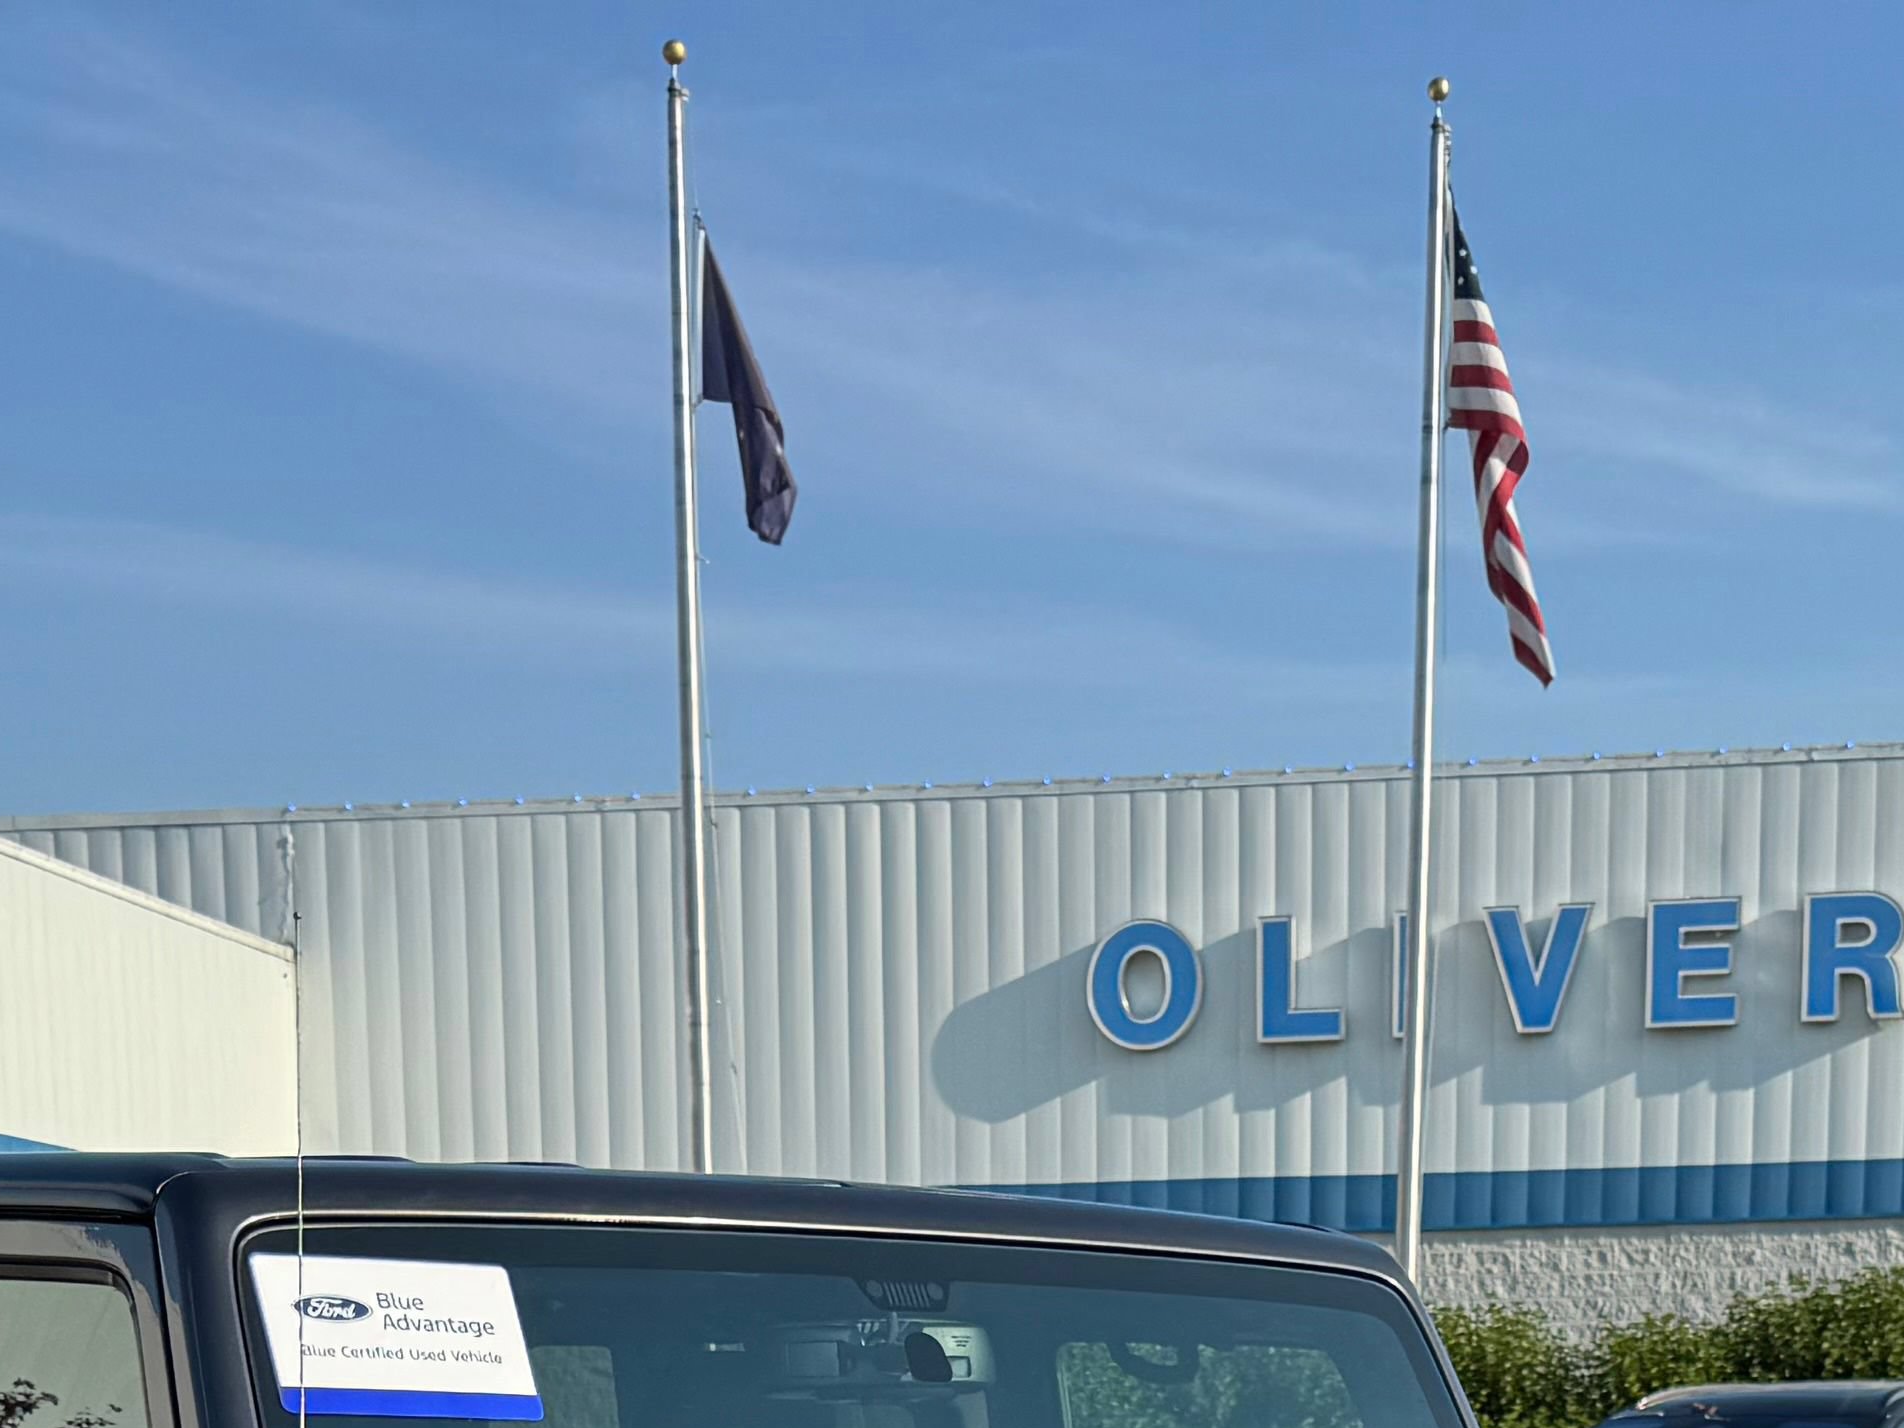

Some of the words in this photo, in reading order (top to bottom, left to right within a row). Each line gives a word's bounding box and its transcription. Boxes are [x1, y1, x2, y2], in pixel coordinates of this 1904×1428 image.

[305, 1295, 358, 1321] Ford
[376, 1292, 424, 1311] Blue
[383, 1313, 495, 1338] Advantage
[300, 1343, 336, 1358] Blue
[341, 1345, 404, 1361] Certified
[409, 1349, 447, 1363] Used
[451, 1350, 502, 1365] Vehicle
